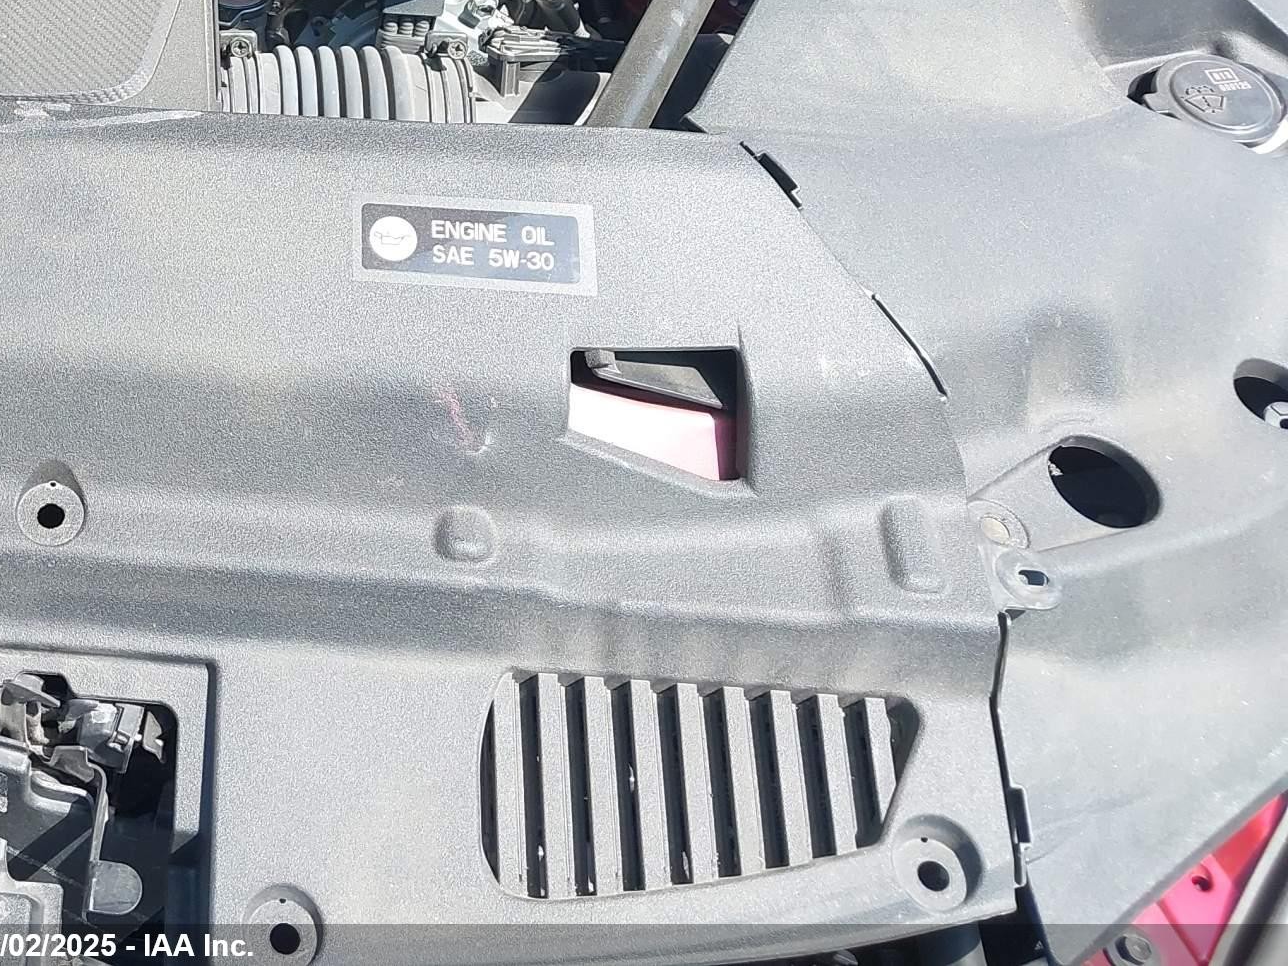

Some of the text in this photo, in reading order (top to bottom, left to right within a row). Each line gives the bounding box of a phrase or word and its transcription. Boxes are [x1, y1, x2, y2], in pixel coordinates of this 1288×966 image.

[431, 220, 554, 246] ENGINE OIL
[432, 245, 555, 270] SAE 5W-30
